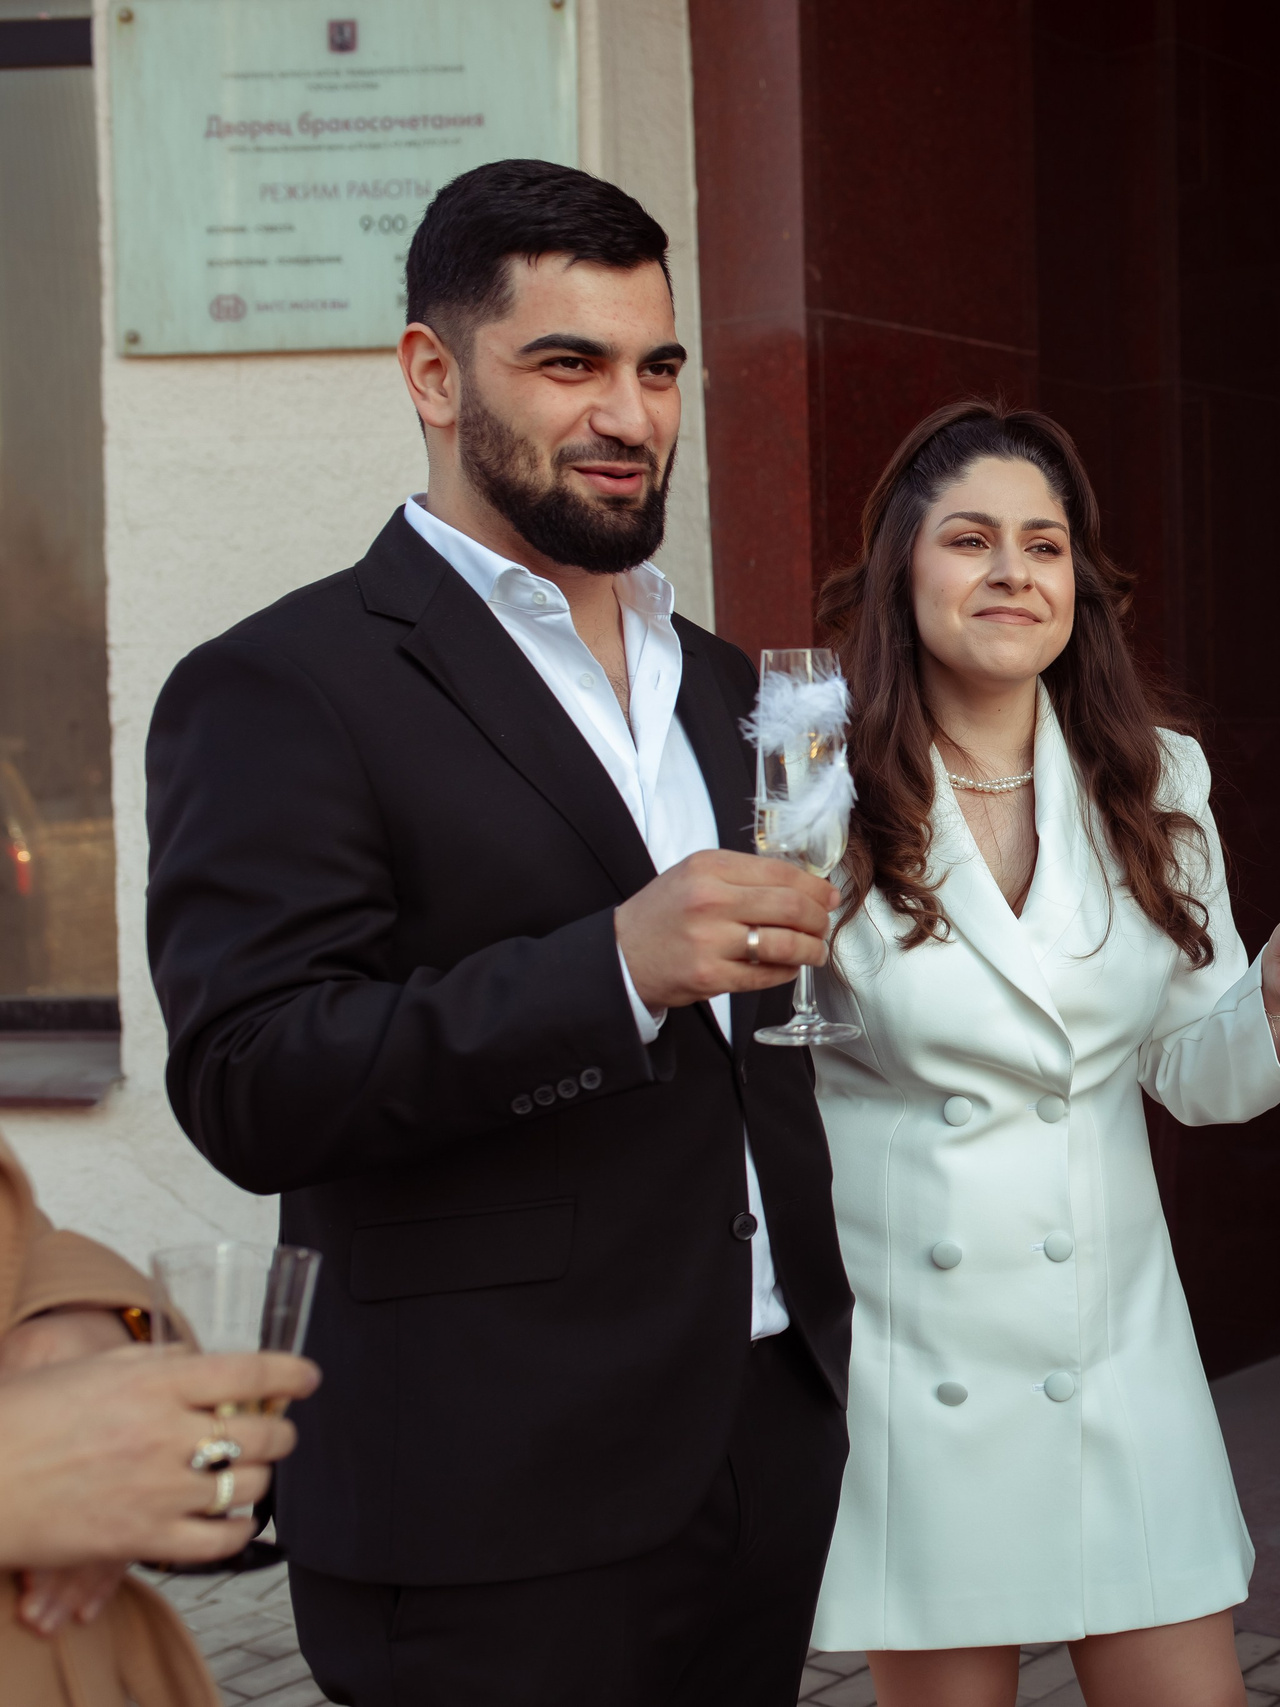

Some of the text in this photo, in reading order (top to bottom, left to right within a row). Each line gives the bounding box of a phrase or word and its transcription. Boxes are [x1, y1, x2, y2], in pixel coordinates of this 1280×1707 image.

[205, 111, 485, 139] Дворец бракосочетания
[259, 179, 432, 202] РЕЖИМ РАБОТЫ
